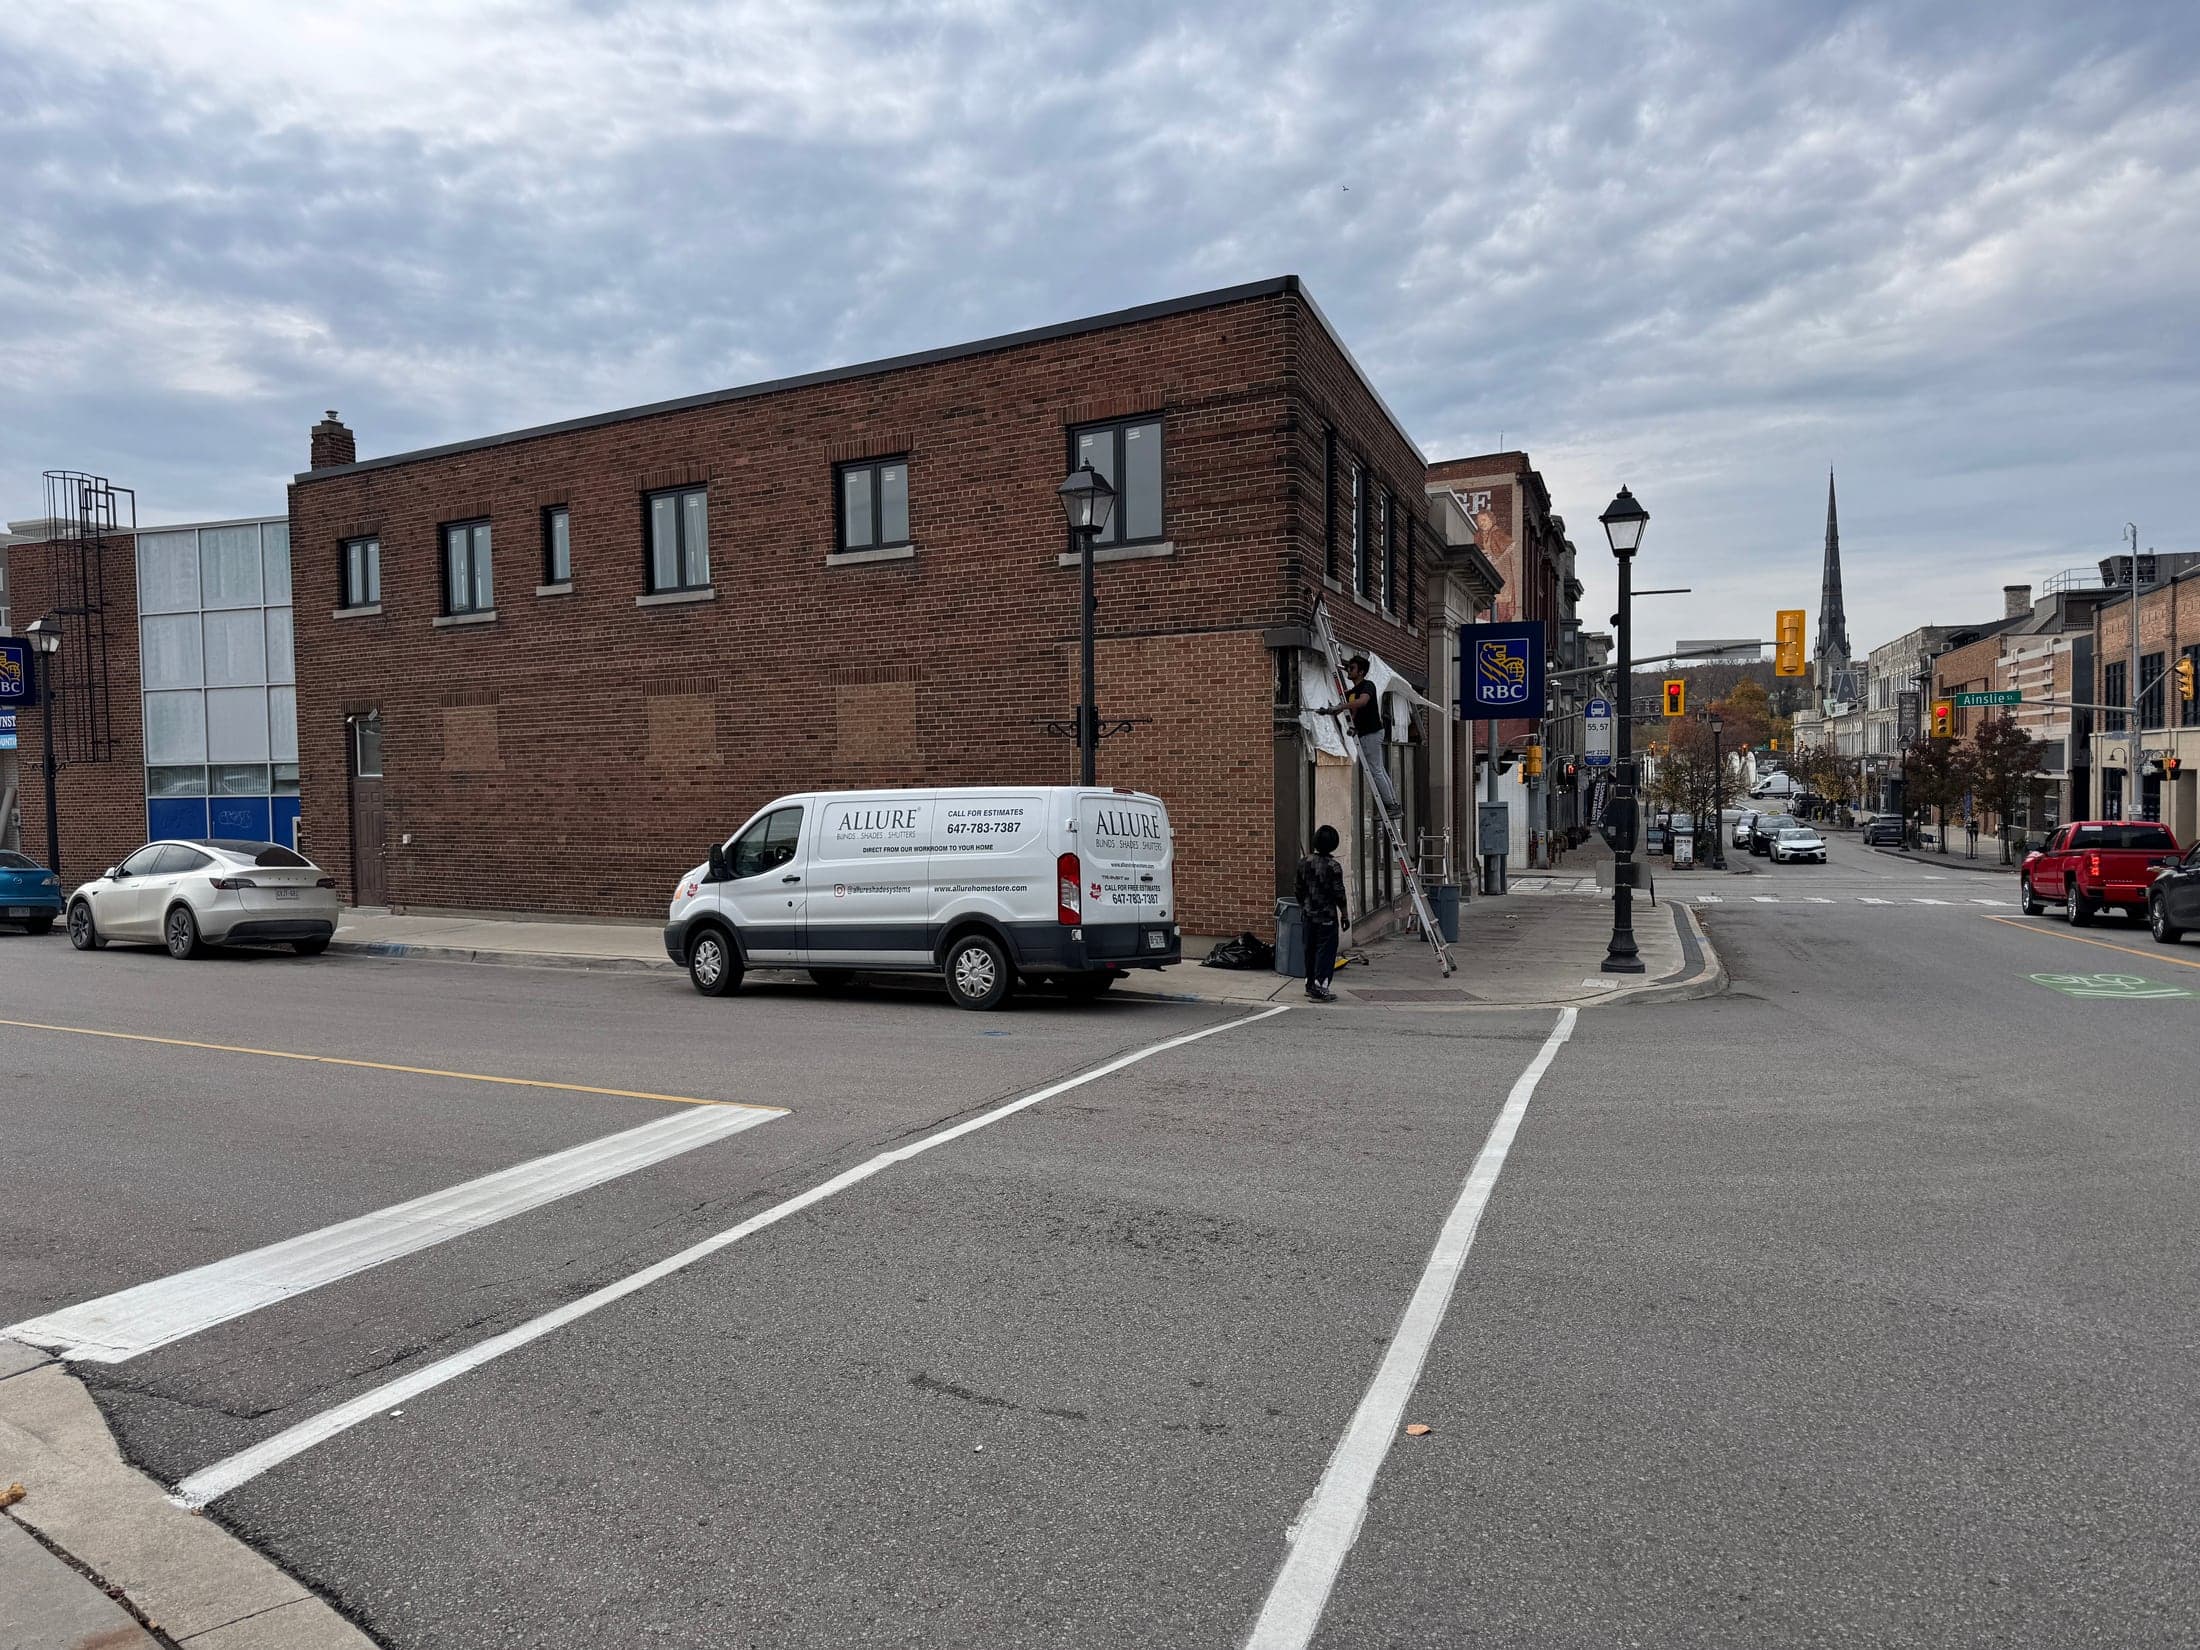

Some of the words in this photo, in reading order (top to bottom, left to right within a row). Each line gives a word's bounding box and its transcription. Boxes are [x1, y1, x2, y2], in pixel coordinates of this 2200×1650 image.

[0, 682, 20, 693] BC
[1482, 685, 1523, 699] RBC
[1963, 694, 2005, 705] Ainslie
[1599, 723, 1609, 731] 57
[967, 809, 982, 817] FOR
[983, 808, 1024, 816] ESTIMATES
[838, 809, 917, 830] ALLURE
[1096, 809, 1160, 839] ALLURE
[947, 822, 1021, 834] 647-783-7387
[888, 830, 916, 839] SHUTTERS
[934, 884, 1027, 893] www.allurehomestore.com
[1112, 893, 1159, 904] 647-783-7387
